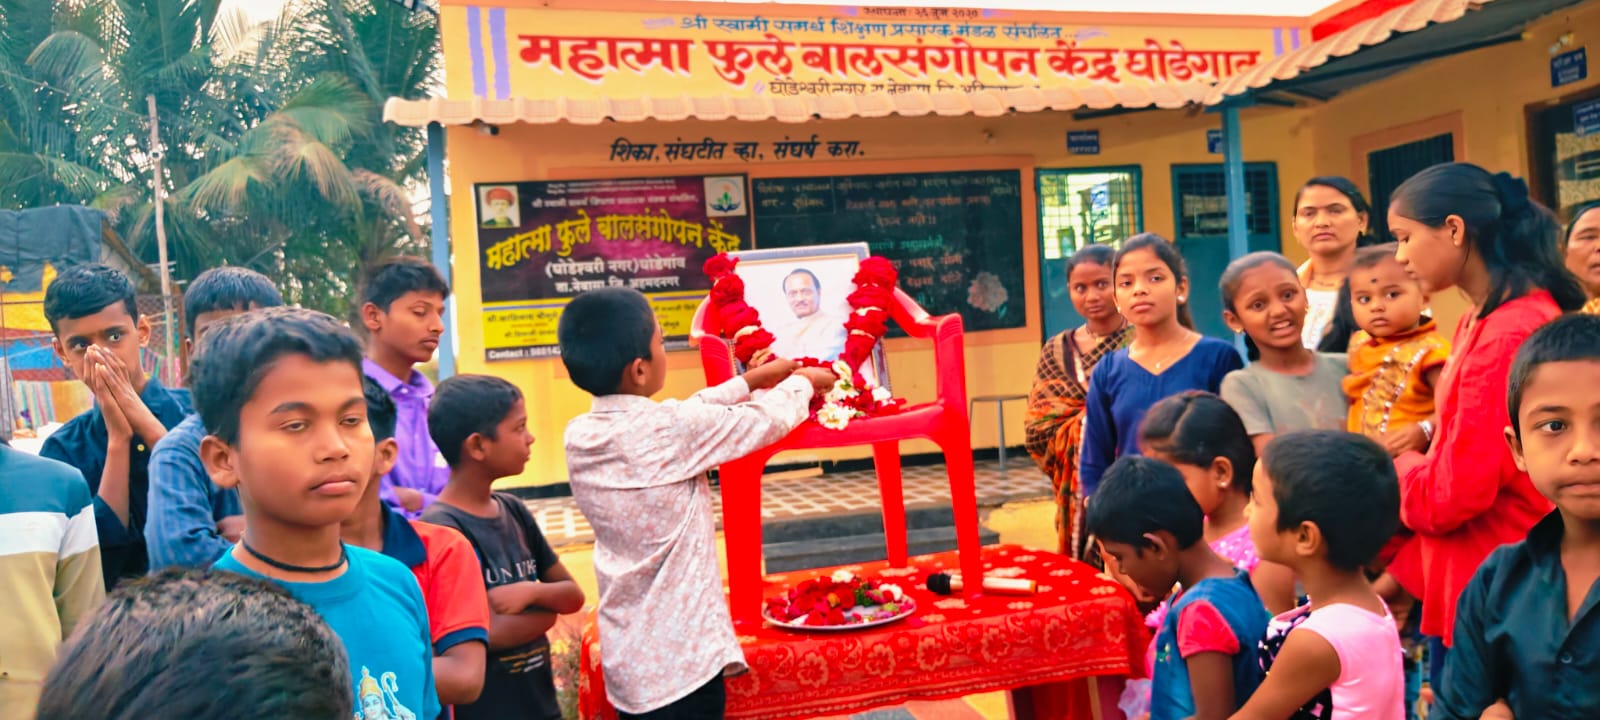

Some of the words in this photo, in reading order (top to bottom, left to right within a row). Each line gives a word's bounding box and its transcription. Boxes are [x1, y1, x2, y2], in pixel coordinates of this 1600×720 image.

[680, 14, 708, 30] श्री
[712, 15, 770, 33] स्वामी
[774, 17, 825, 34] समर्थ
[830, 18, 887, 39] शिक्षण
[891, 22, 953, 38] प्रसारक
[956, 22, 998, 39] मंडळ
[518, 34, 695, 79] महात्मा
[702, 33, 797, 86] फुले
[801, 37, 1041, 81] बालसंगोपन
[1046, 38, 1121, 84] केंद्र
[664, 137, 728, 162] संघटीत
[772, 134, 821, 159] संघर्ष
[486, 223, 552, 270] महात्मा
[556, 208, 591, 257] फुले
[596, 207, 703, 248] बालसंगोपन
[488, 349, 524, 359] Contact
